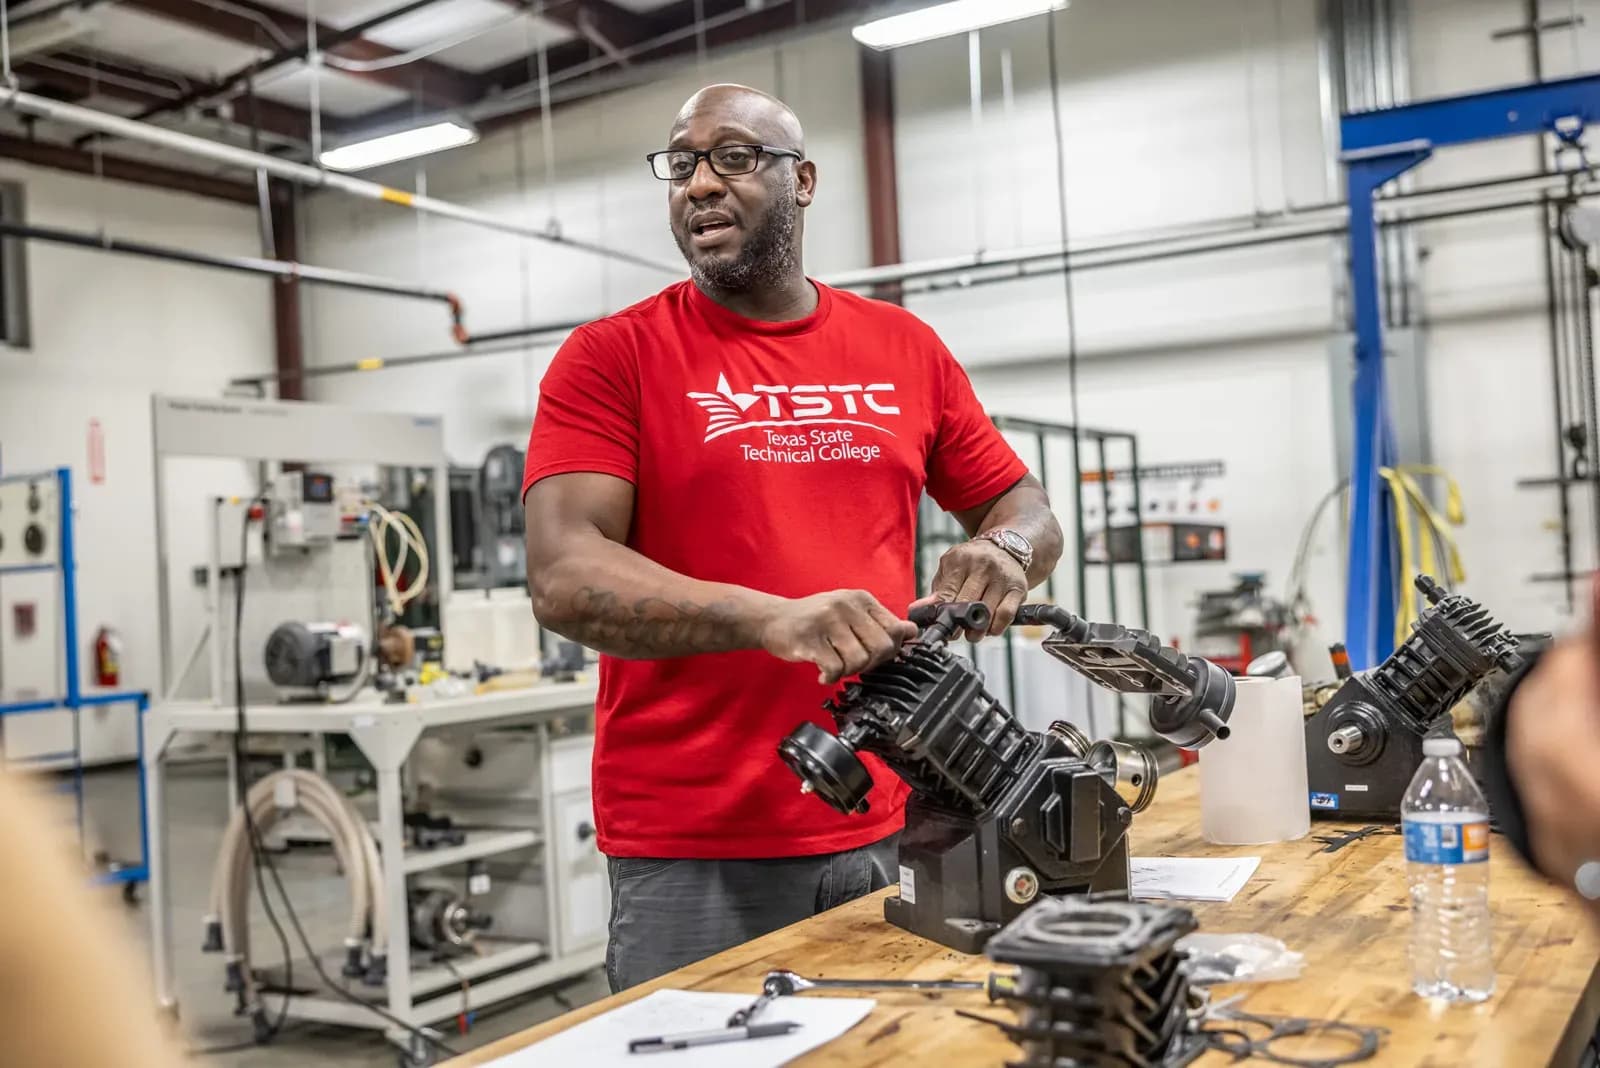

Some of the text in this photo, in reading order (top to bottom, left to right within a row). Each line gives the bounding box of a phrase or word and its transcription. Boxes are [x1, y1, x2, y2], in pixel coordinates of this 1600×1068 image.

[753, 383, 900, 418] TSTC
[764, 429, 853, 446] Texas State
[740, 442, 880, 463] Technical College
